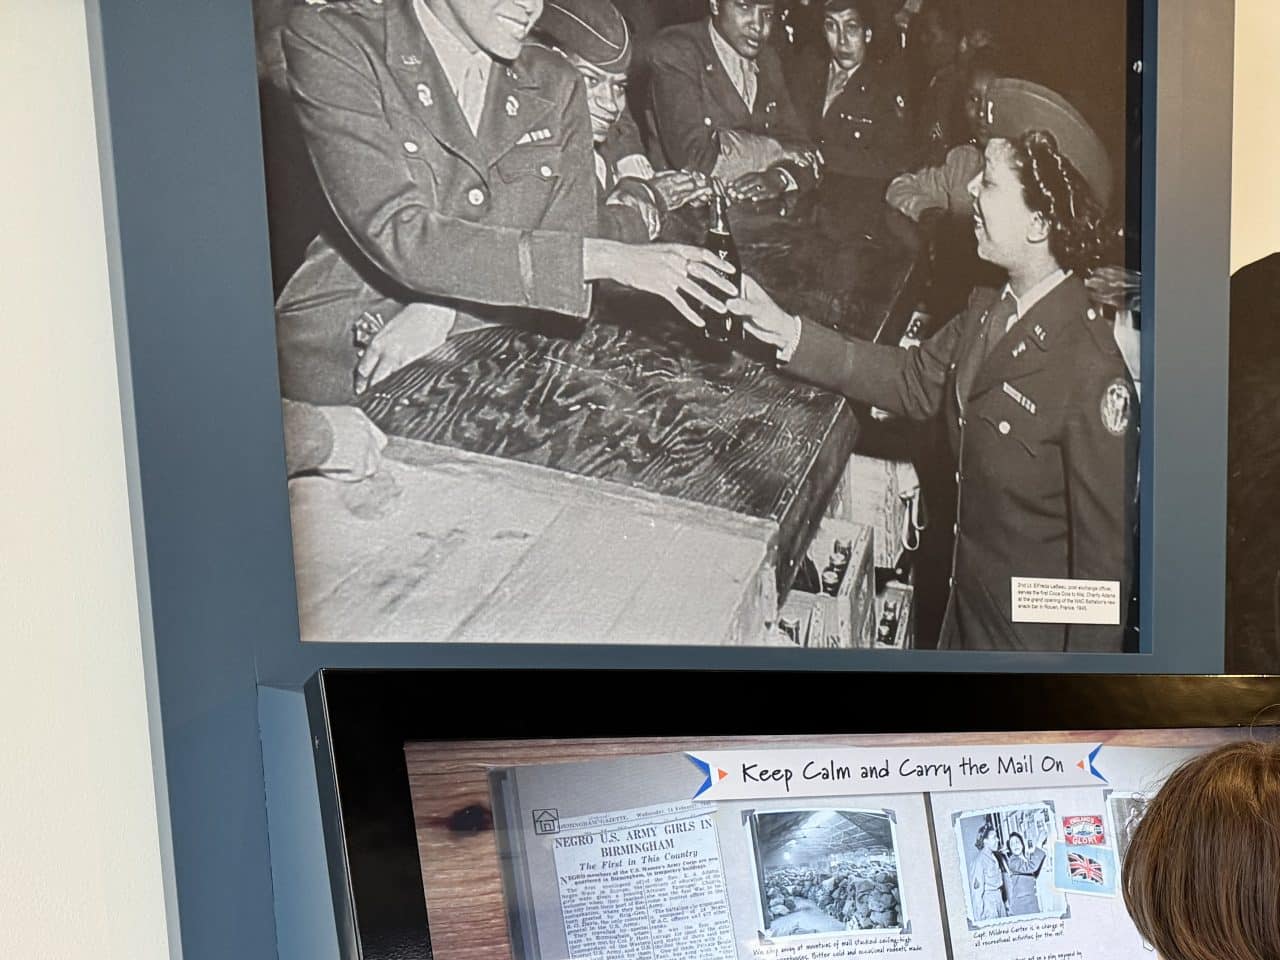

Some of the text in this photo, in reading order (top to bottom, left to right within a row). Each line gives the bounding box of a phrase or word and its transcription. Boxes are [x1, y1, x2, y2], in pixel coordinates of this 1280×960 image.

[742, 754, 1064, 791] Keep Calm and Carry the Mail On
[555, 818, 713, 849] NEGRO U.S. ARMY GIRLS IN
[579, 850, 698, 871] The First in This Country
[601, 838, 675, 858] BIRMINGHAM
